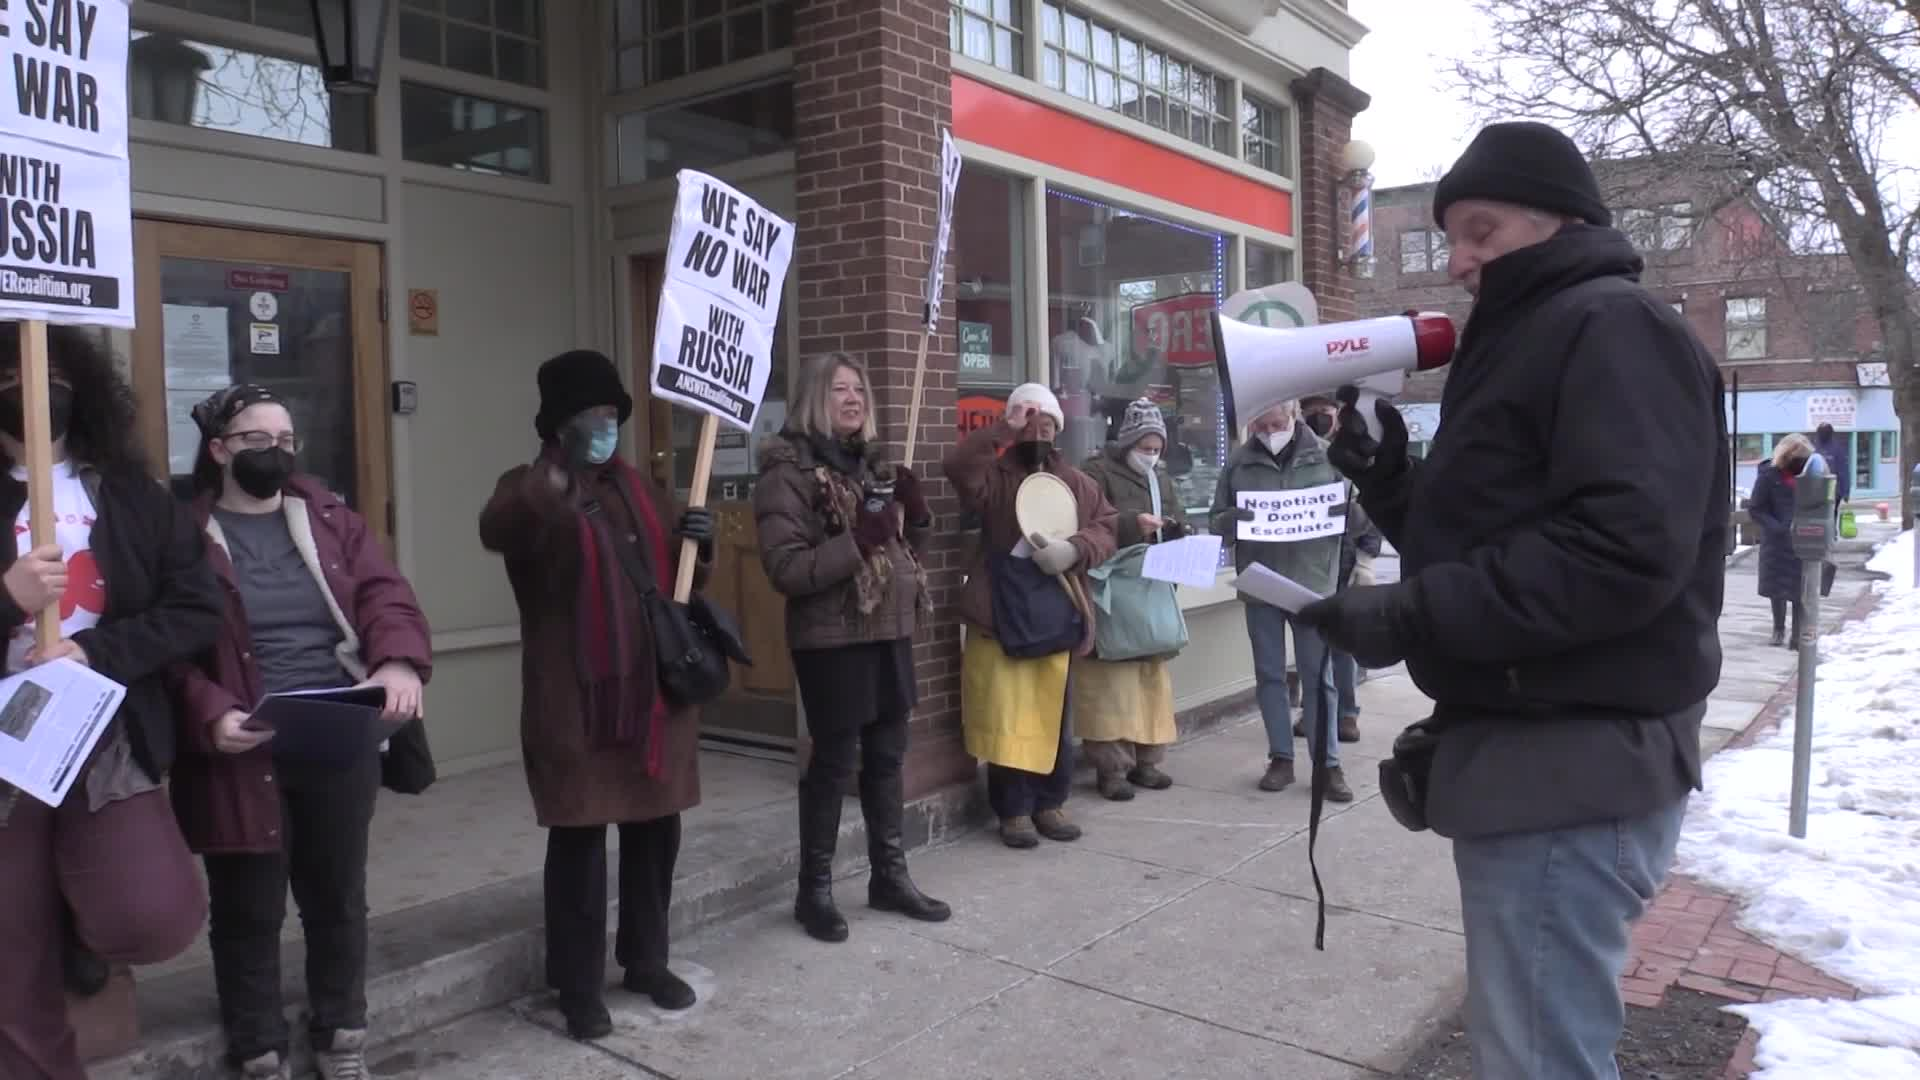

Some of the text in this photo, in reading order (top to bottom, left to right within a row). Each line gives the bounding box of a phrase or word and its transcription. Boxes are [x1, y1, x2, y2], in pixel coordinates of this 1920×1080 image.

[25, 0, 97, 61] SAY
[13, 52, 99, 133] WAR
[0, 153, 61, 204] WITH
[0, 197, 96, 269] SSIA
[701, 183, 781, 261] WE SAY
[683, 230, 770, 309] NO WAR
[708, 304, 745, 347] WITH
[1327, 336, 1369, 355] PYLE
[678, 324, 754, 395] RUSSIA
[962, 352, 991, 369] OPEN
[1244, 493, 1337, 512] Negotiate
[1267, 509, 1316, 522] Don't
[1250, 521, 1334, 536] Escalate
